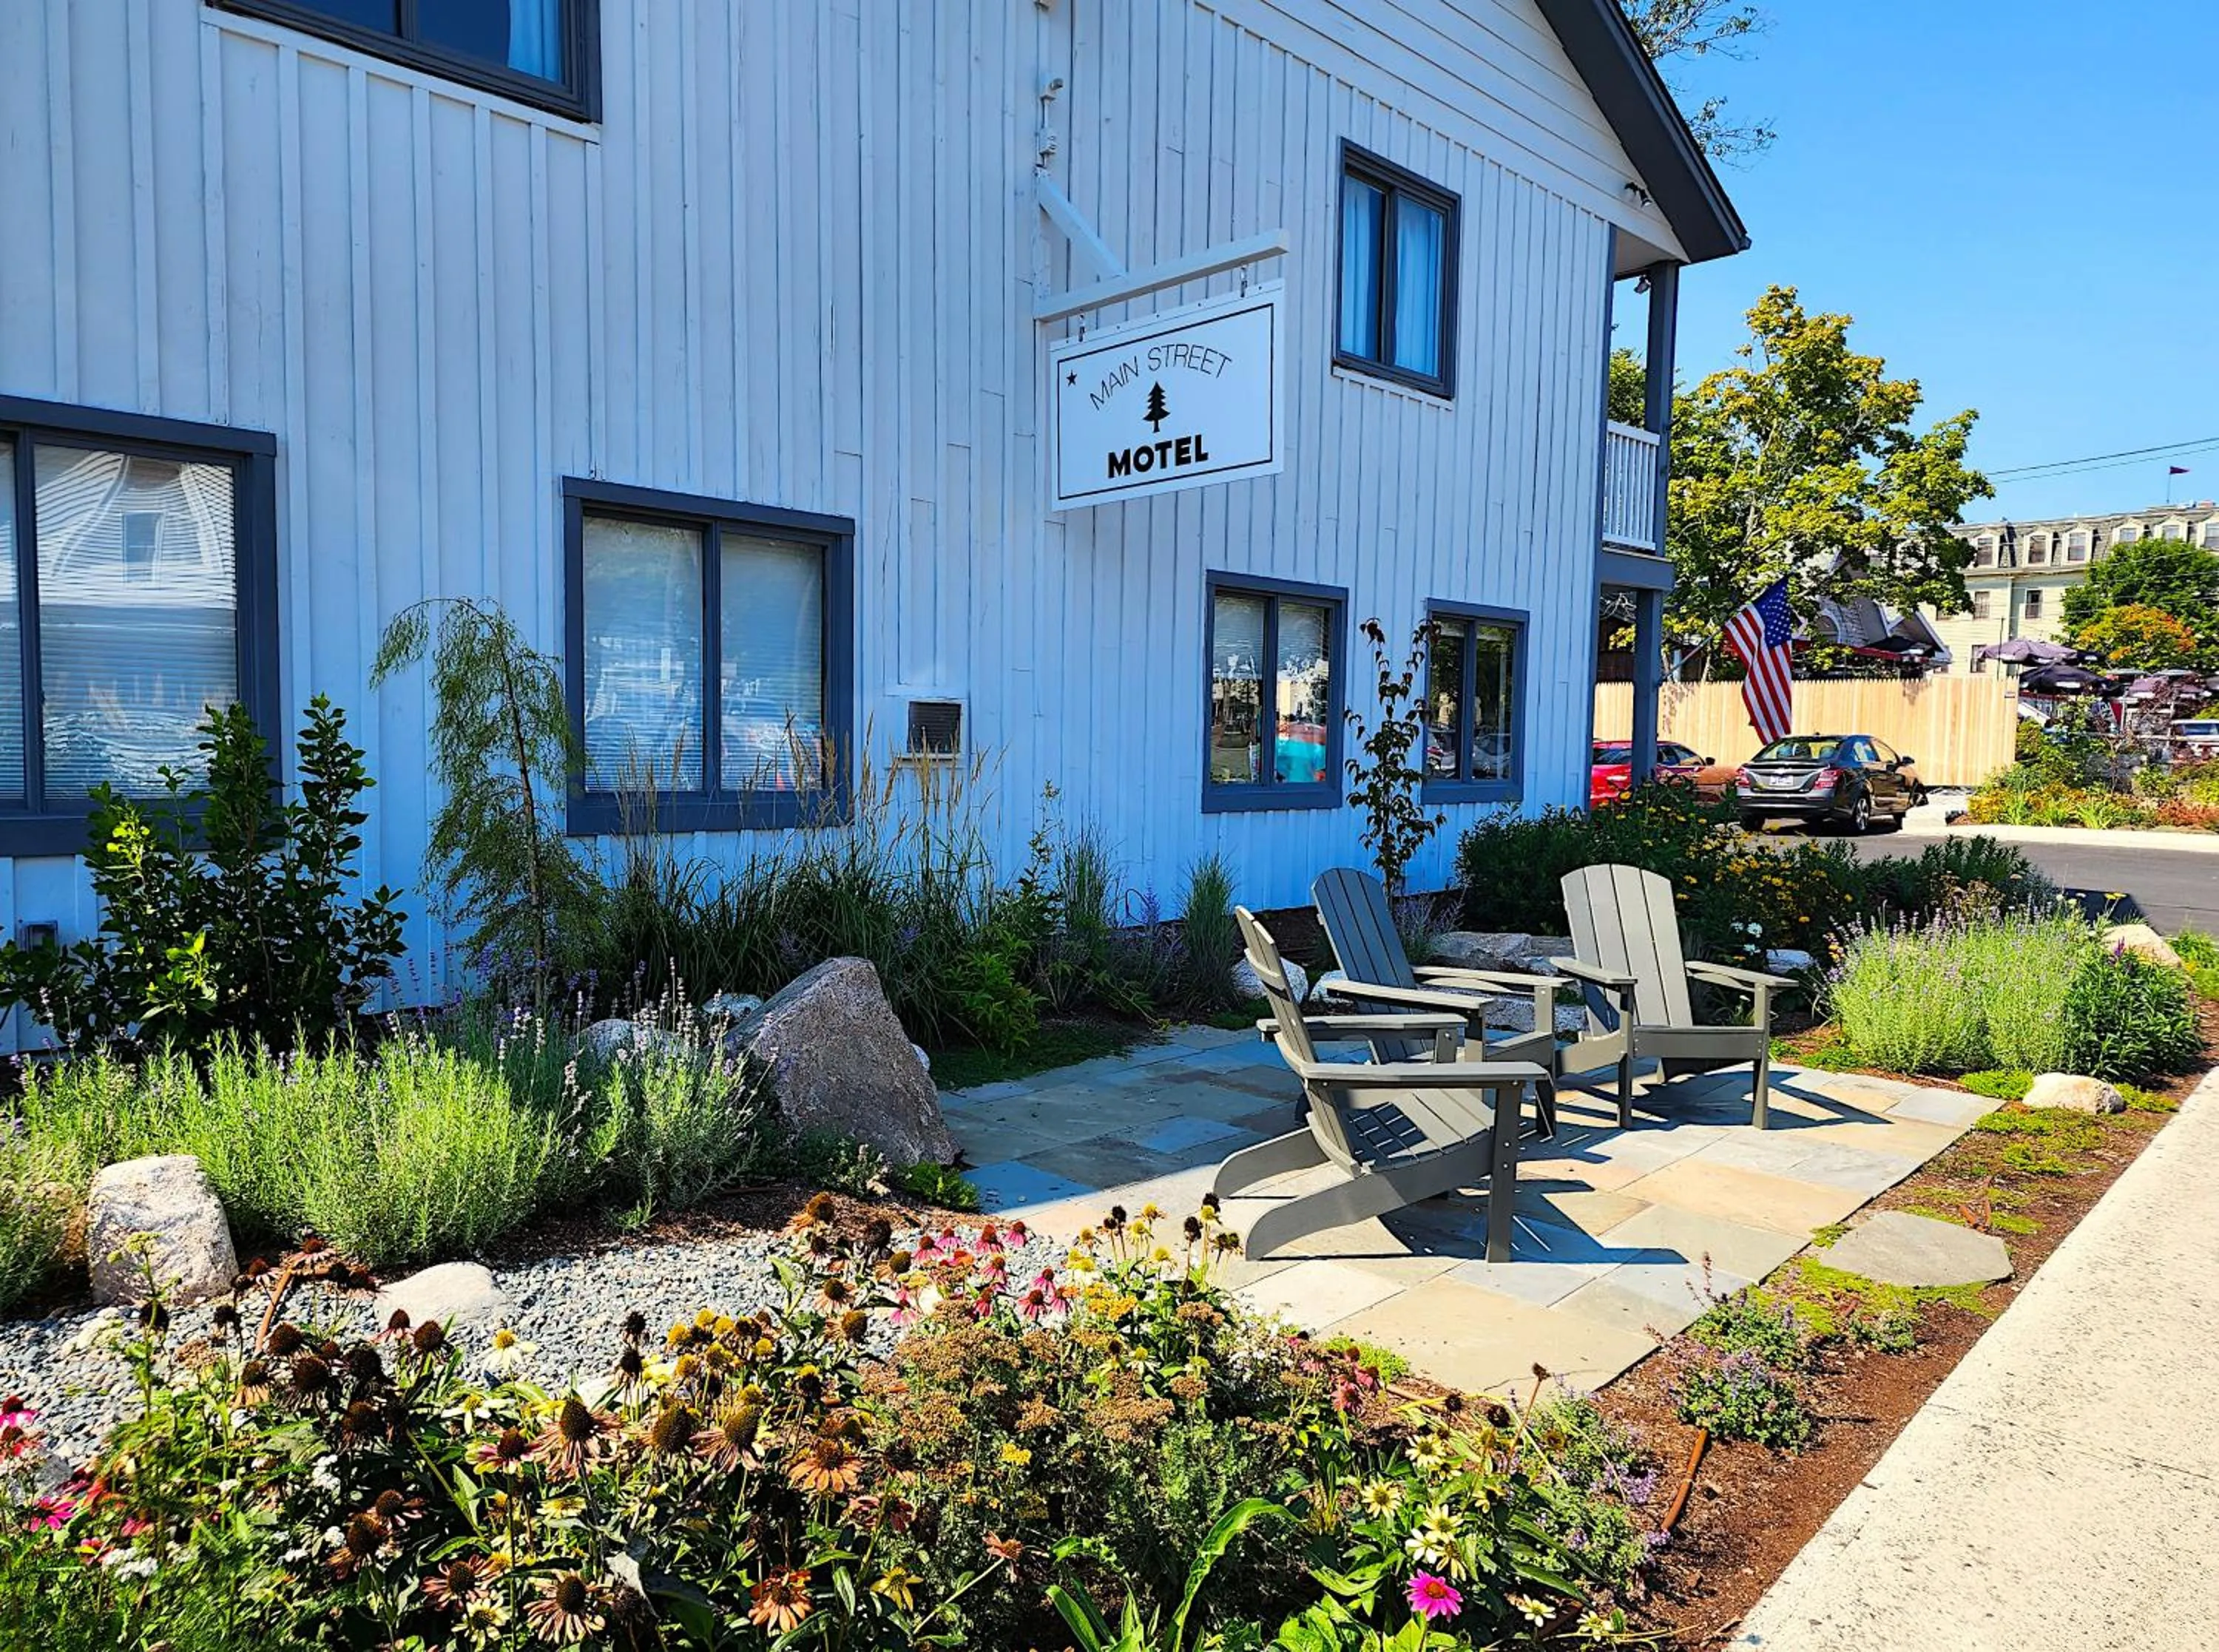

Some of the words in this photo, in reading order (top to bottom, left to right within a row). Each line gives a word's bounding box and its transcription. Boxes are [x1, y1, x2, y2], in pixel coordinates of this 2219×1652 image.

[1090, 356, 1139, 410] MAIN
[1147, 344, 1232, 379] STREET
[1108, 435, 1208, 478] MOTEL
